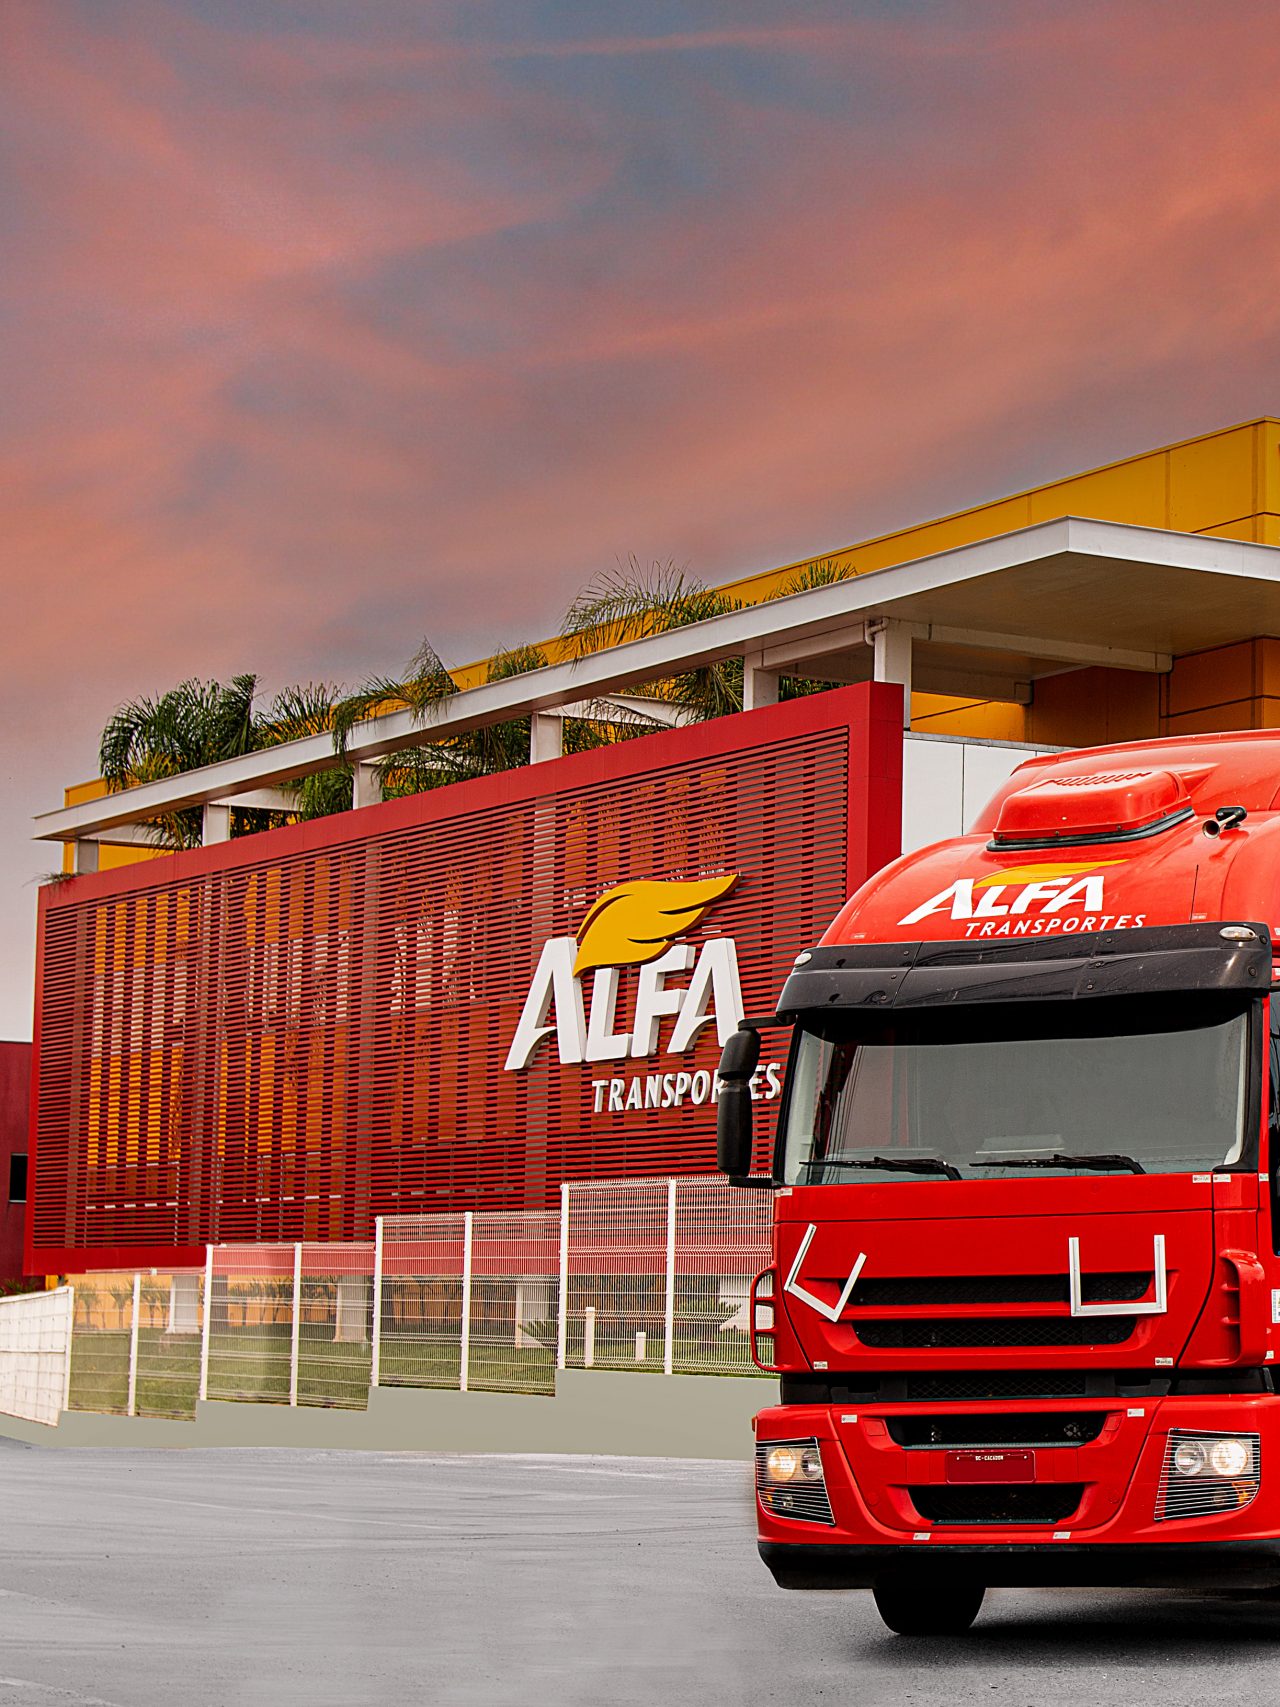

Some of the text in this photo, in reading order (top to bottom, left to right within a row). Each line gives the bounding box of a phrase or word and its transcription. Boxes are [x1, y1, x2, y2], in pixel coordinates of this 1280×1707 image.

[896, 875, 1105, 926] ALFA
[964, 914, 1147, 938] TRANSPORTES
[503, 936, 746, 1072] ALFA
[591, 1062, 782, 1113] TRANSPORES
